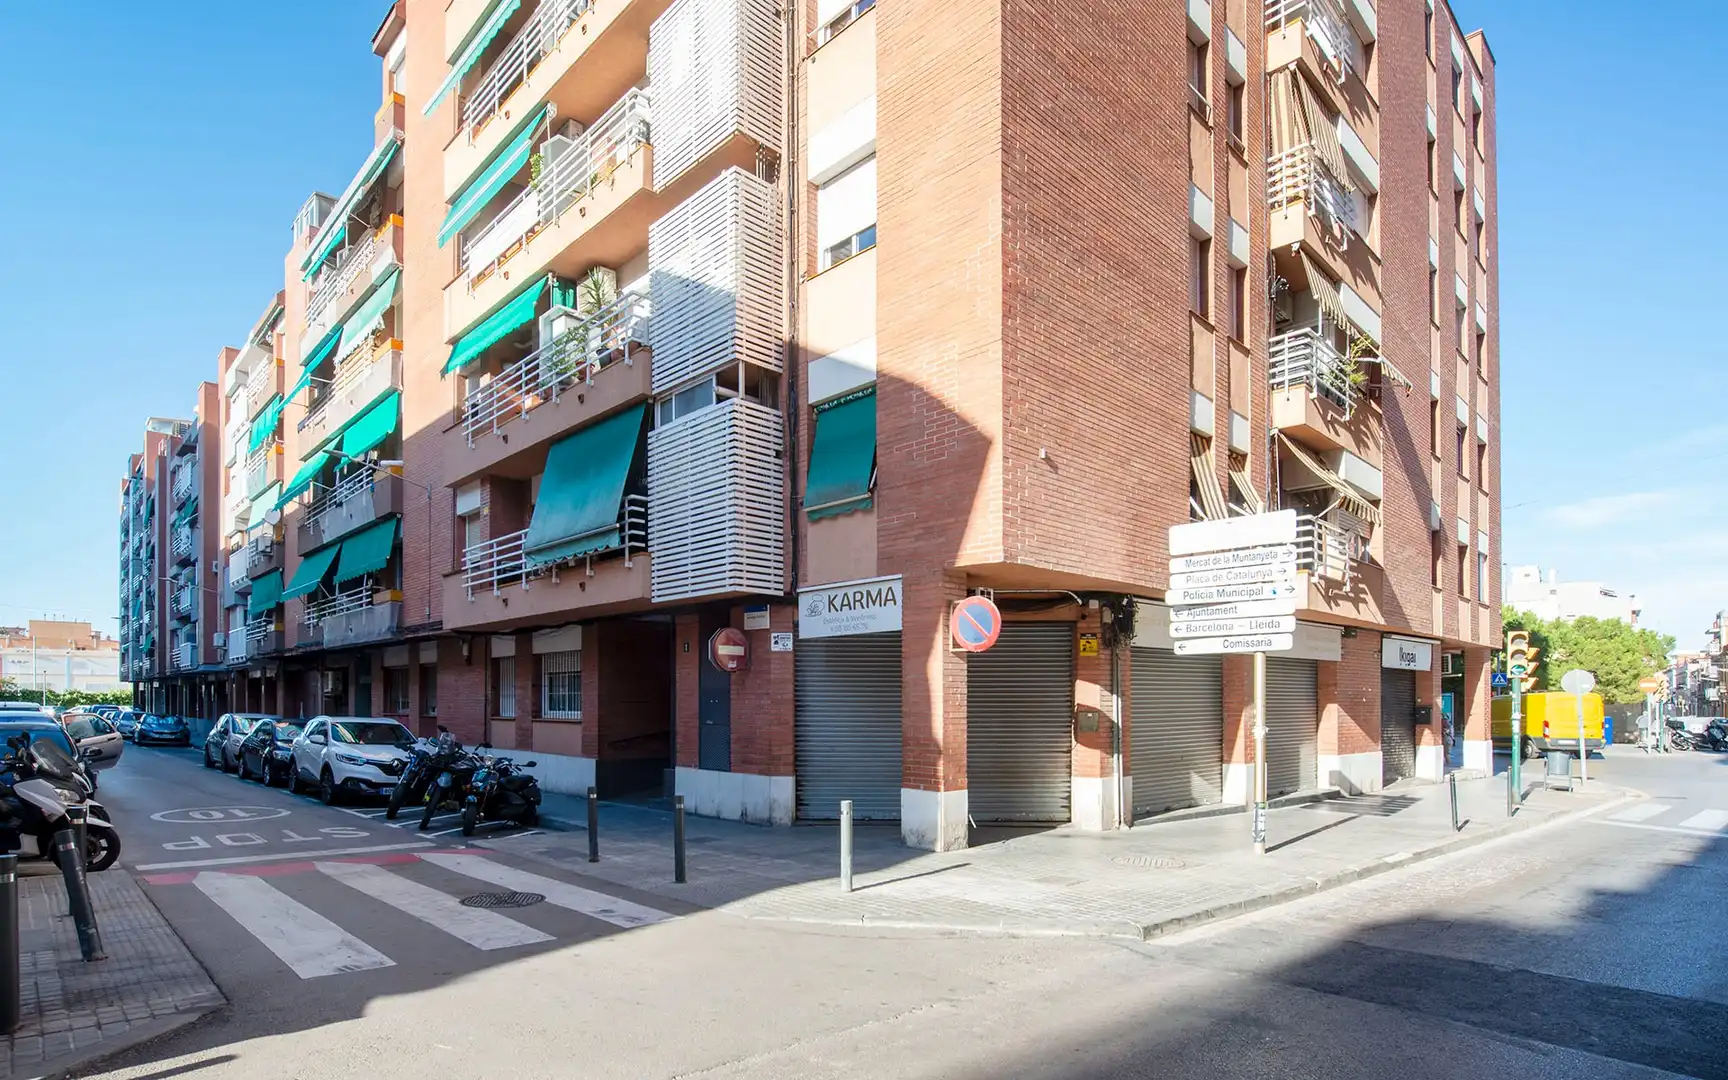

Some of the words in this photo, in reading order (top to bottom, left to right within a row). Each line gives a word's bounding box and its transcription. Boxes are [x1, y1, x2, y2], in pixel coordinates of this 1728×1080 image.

[1185, 557, 1211, 569] Mercat
[1212, 556, 1222, 566] de
[1223, 555, 1230, 565] la
[1232, 550, 1278, 563] Muntanyeta
[1212, 572, 1223, 582] de
[1226, 569, 1273, 581] Catalunya
[1216, 586, 1264, 599] Municipal
[827, 586, 897, 613] KARMA
[1187, 605, 1238, 619] Ajuntament
[1186, 622, 1234, 633] Barcelona
[1249, 620, 1281, 630] Lleida
[1222, 637, 1273, 649] Comissaria
[188, 808, 257, 820] 10
[162, 826, 370, 851] STOP
